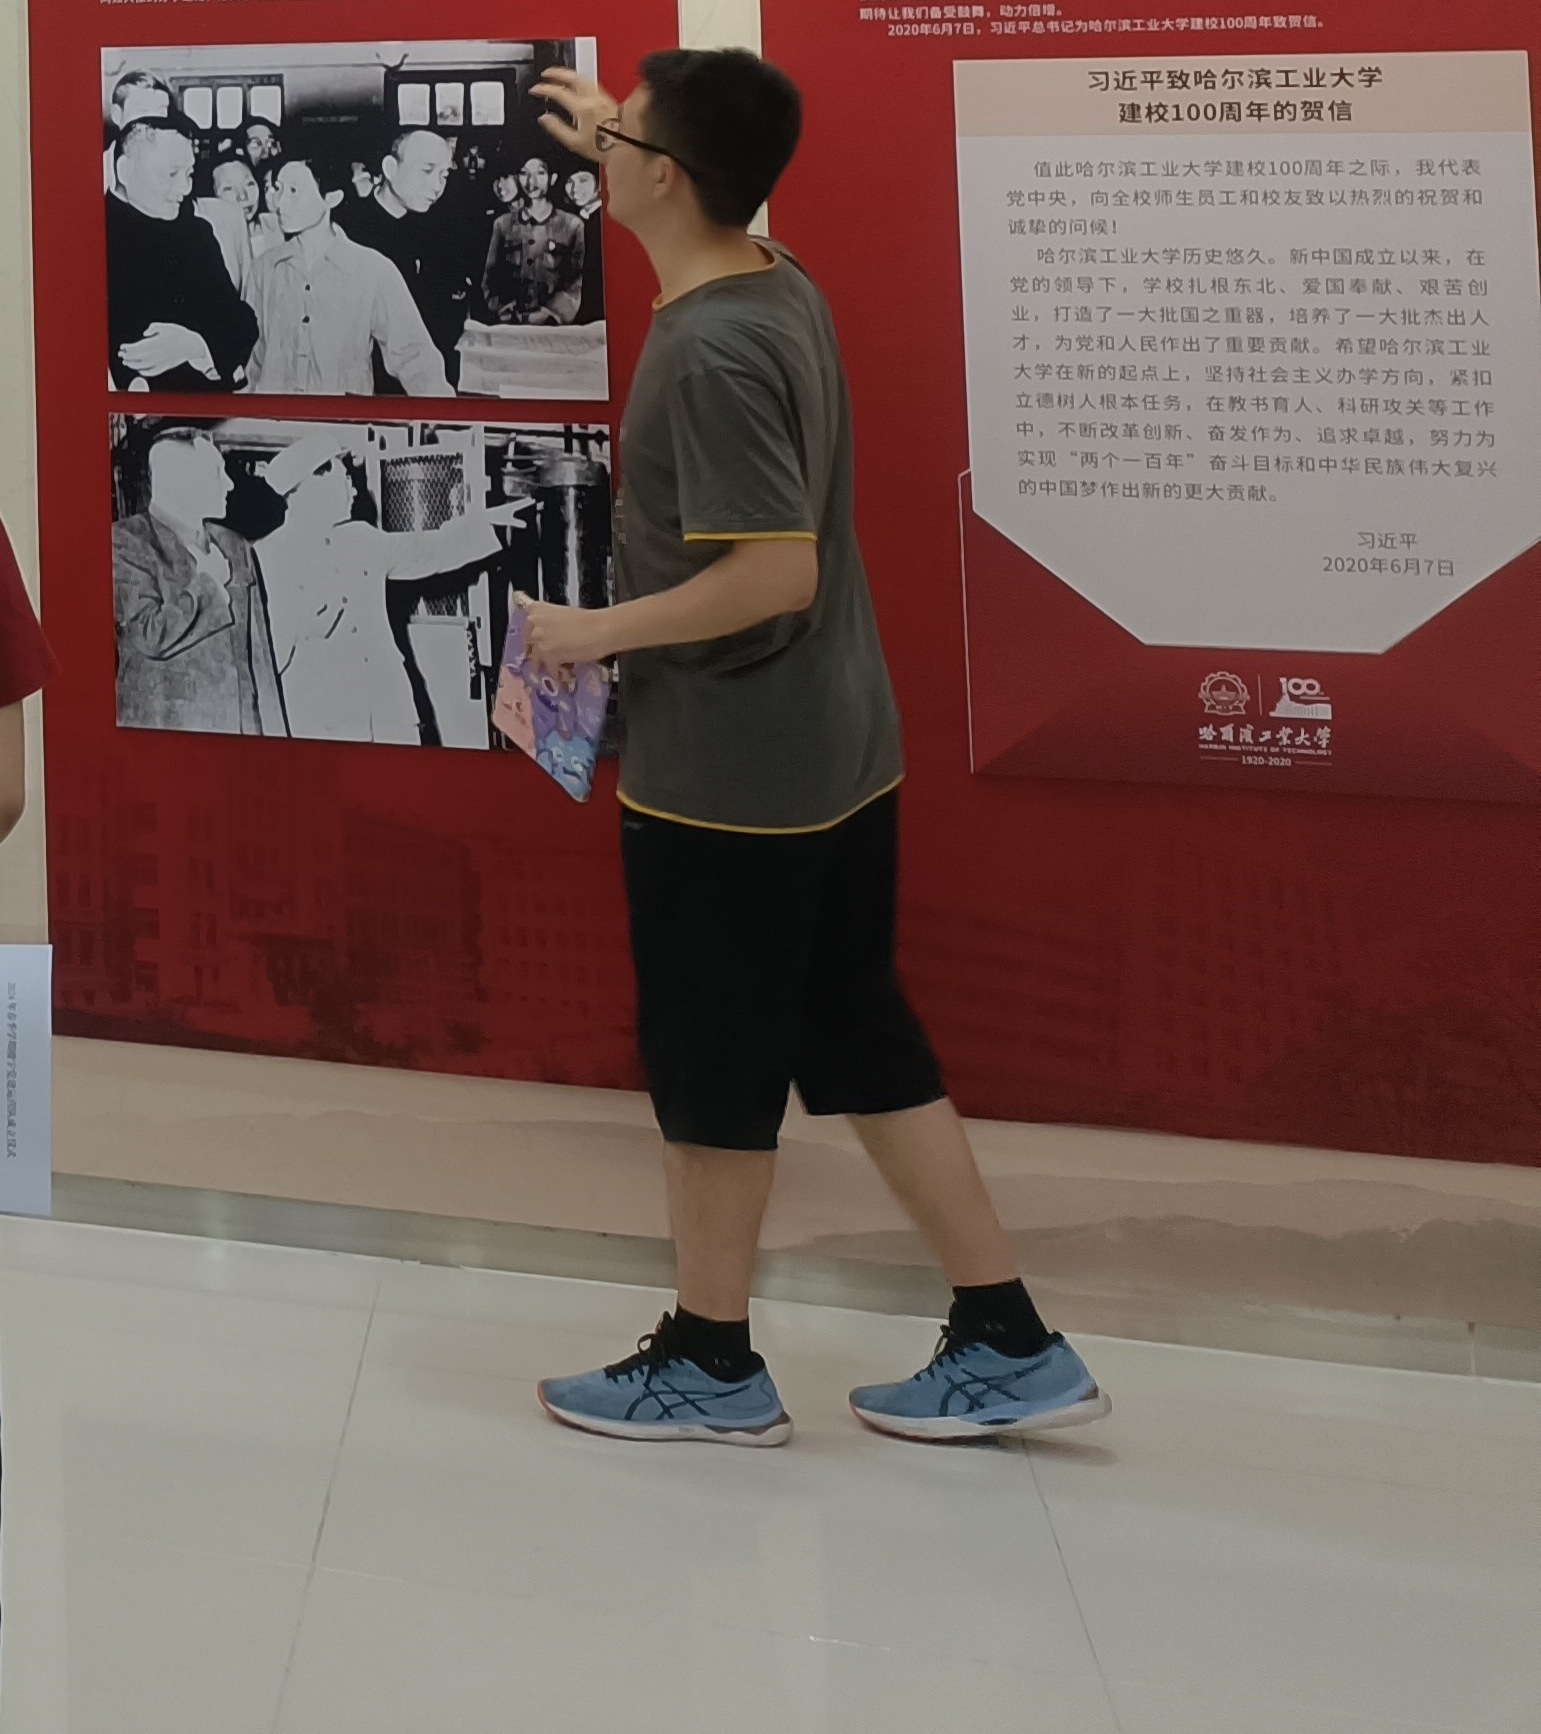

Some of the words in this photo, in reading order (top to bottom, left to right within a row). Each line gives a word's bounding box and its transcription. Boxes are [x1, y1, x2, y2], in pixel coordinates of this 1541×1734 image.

[1087, 66, 1383, 92] 习近平致哈尔滨工业大学
[1118, 99, 1353, 124] 建校100周年的贺信
[1357, 531, 1418, 550] 习近平
[1322, 556, 1455, 578] 2020年6月7日
